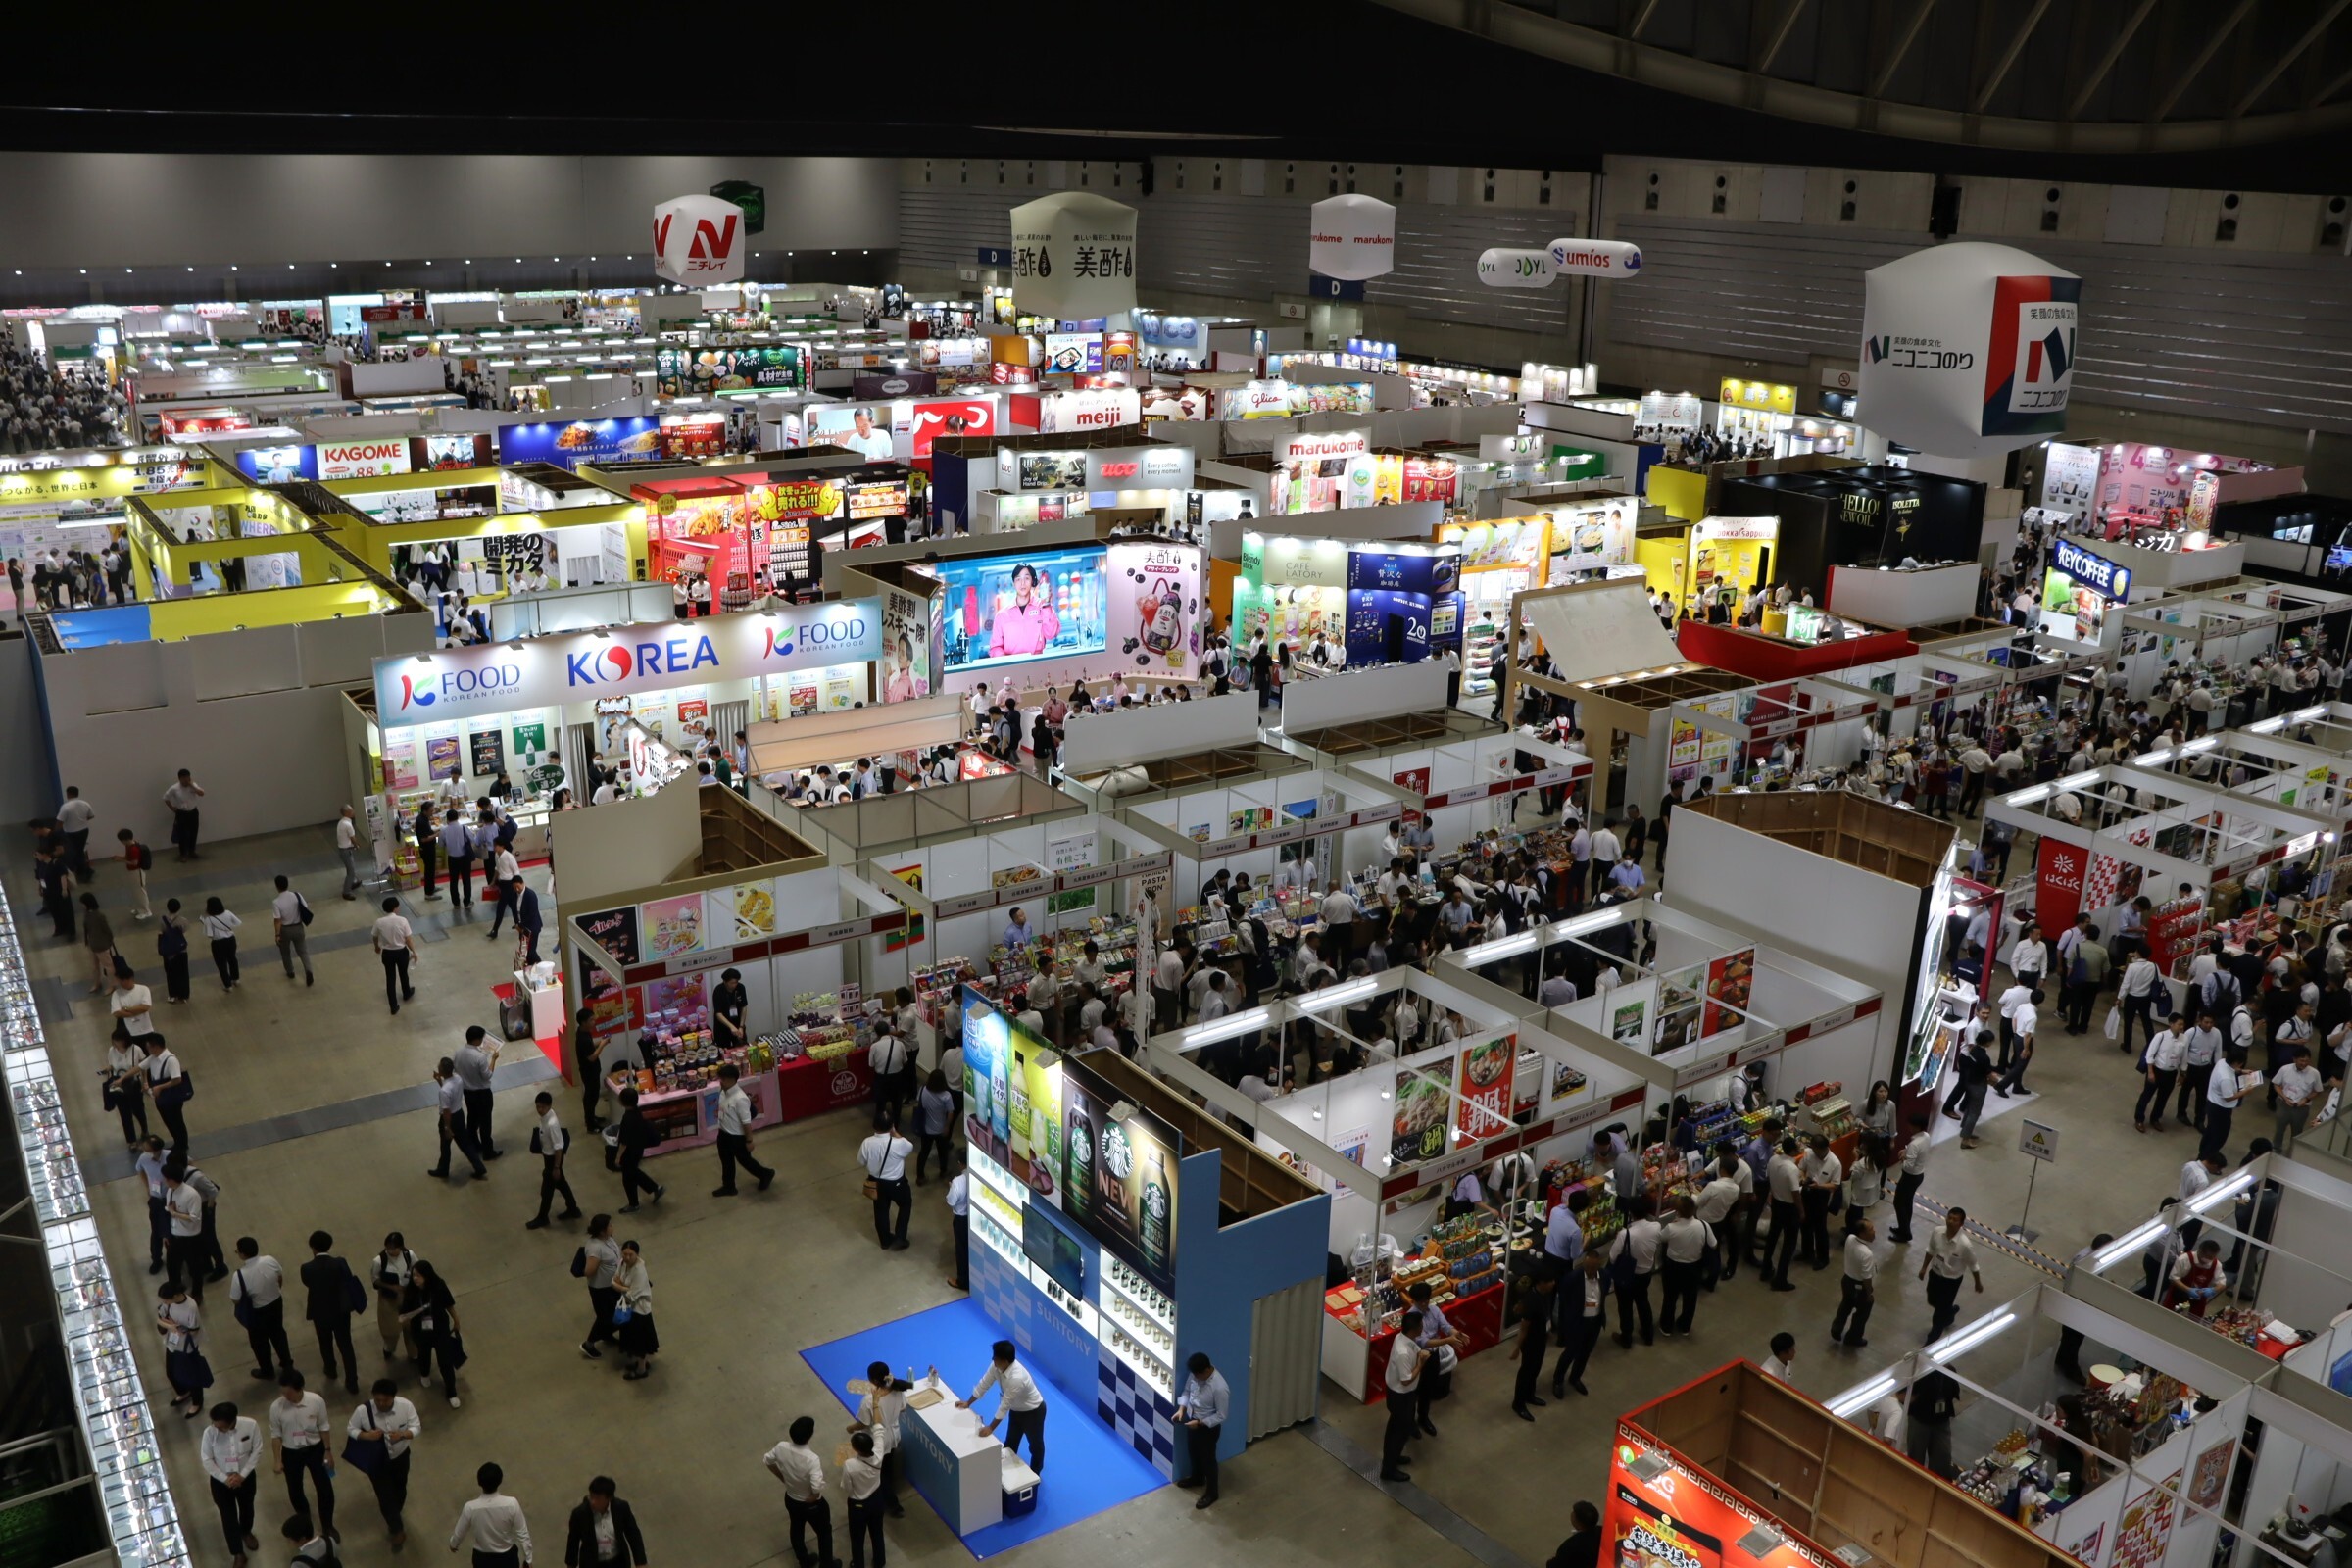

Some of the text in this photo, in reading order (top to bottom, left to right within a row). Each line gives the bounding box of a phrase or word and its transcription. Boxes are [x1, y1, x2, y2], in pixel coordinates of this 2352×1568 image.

[1310, 235, 1343, 244] arukome
[1353, 235, 1393, 245] marukome
[687, 260, 727, 271] ニチレイ
[991, 251, 998, 262] D
[1073, 246, 1123, 278] 美酢
[1331, 281, 1340, 294] D
[1891, 348, 1974, 370] ニコニコのり
[1251, 393, 1283, 409] Glico
[1076, 407, 1121, 428] meiji
[324, 443, 402, 463] KAGOME
[1289, 438, 1364, 456] marukome
[777, 484, 820, 496] 秋冬はコレが
[483, 533, 544, 559] 開発の
[485, 549, 544, 576] ミカタ
[1243, 552, 1261, 566] Blendy
[1286, 569, 1323, 580] LATORY
[888, 591, 916, 620] 美酢割
[799, 618, 866, 647] FOOD
[1406, 616, 1427, 639] 20
[799, 639, 864, 654] KOREAN FOOD
[566, 635, 720, 687] KOREA
[441, 663, 521, 695] FOOD
[443, 686, 521, 704] KOREAN FOOD
[1141, 875, 1167, 886] PASTA
[2044, 873, 2081, 891] はくばく
[835, 1082, 855, 1093] ENDO
[1098, 1168, 1136, 1214] NEW
[1036, 1300, 1092, 1357] SUNTORY
